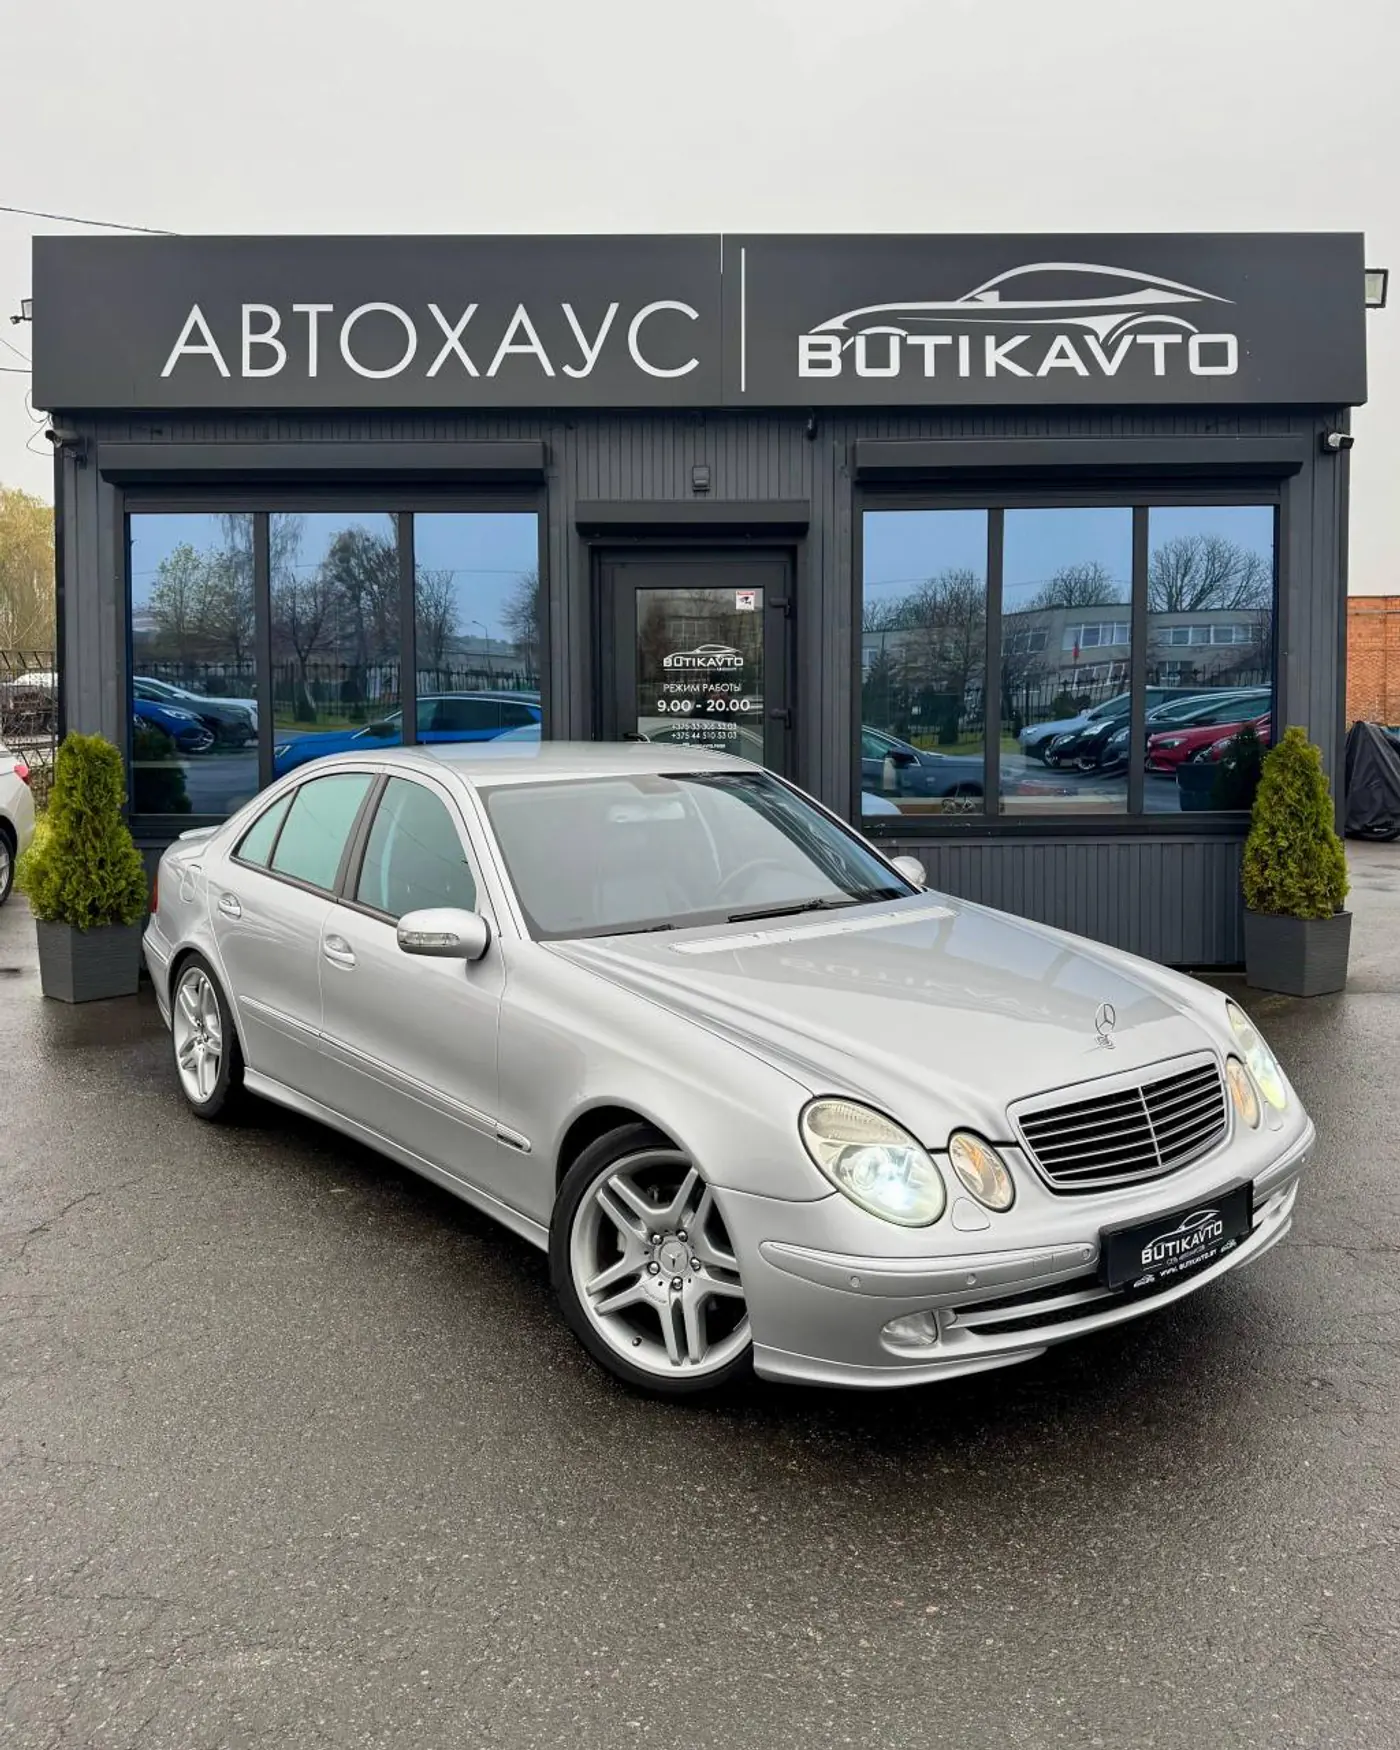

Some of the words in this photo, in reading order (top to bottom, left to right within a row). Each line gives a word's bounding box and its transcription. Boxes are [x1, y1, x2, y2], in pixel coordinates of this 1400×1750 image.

[160, 300, 700, 379] АВТОХАУС
[798, 333, 1239, 378] BUTIKAVTO
[663, 656, 744, 667] BUTIKAVTO
[663, 683, 700, 693] РЕЖИМ
[702, 683, 742, 693] РАБОТЫ
[657, 699, 692, 712] 9.00
[706, 699, 750, 712] 20.00
[671, 731, 690, 739] +375
[691, 731, 700, 739] 44
[717, 731, 726, 739] 53
[727, 731, 737, 739] 03
[1141, 1220, 1223, 1265] BUTIKAVTO
